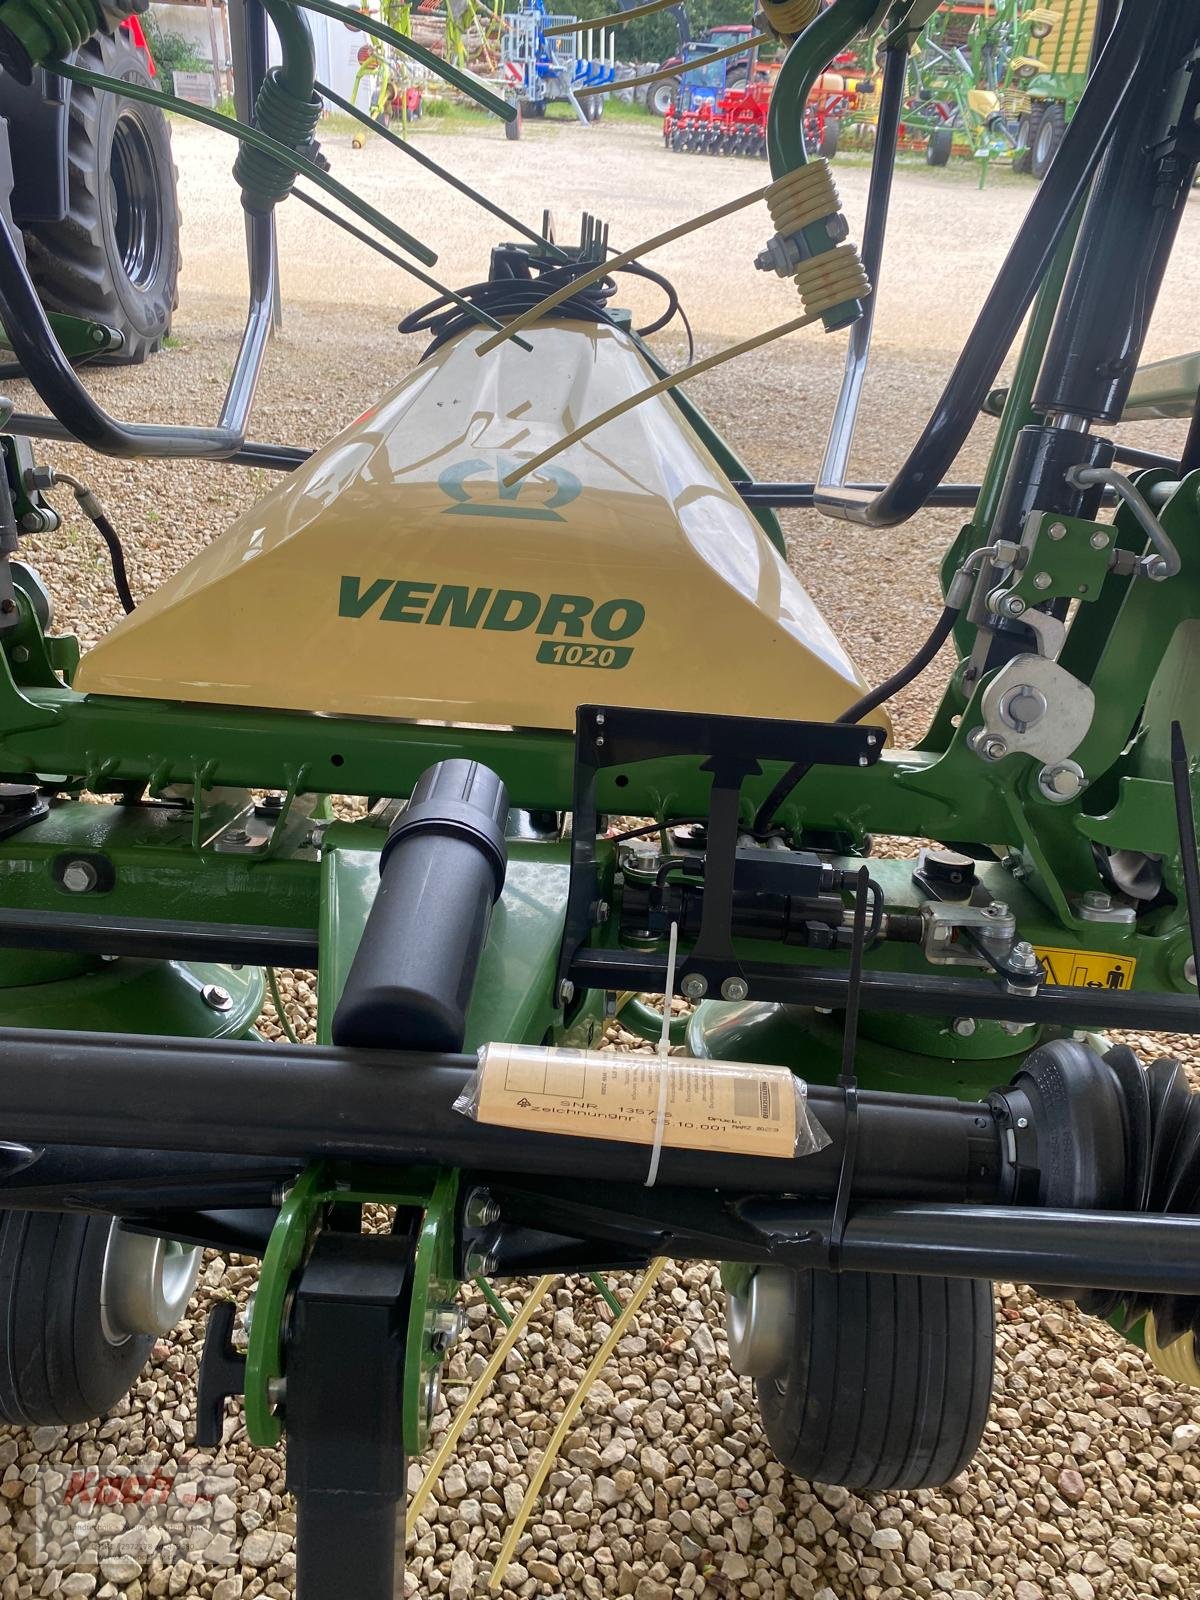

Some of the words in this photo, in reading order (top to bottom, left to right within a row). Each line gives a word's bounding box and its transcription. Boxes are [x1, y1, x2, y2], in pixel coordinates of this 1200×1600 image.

[338, 575, 646, 641] VENDRO
[552, 643, 616, 667] 1020
[560, 1100, 599, 1110] SNR
